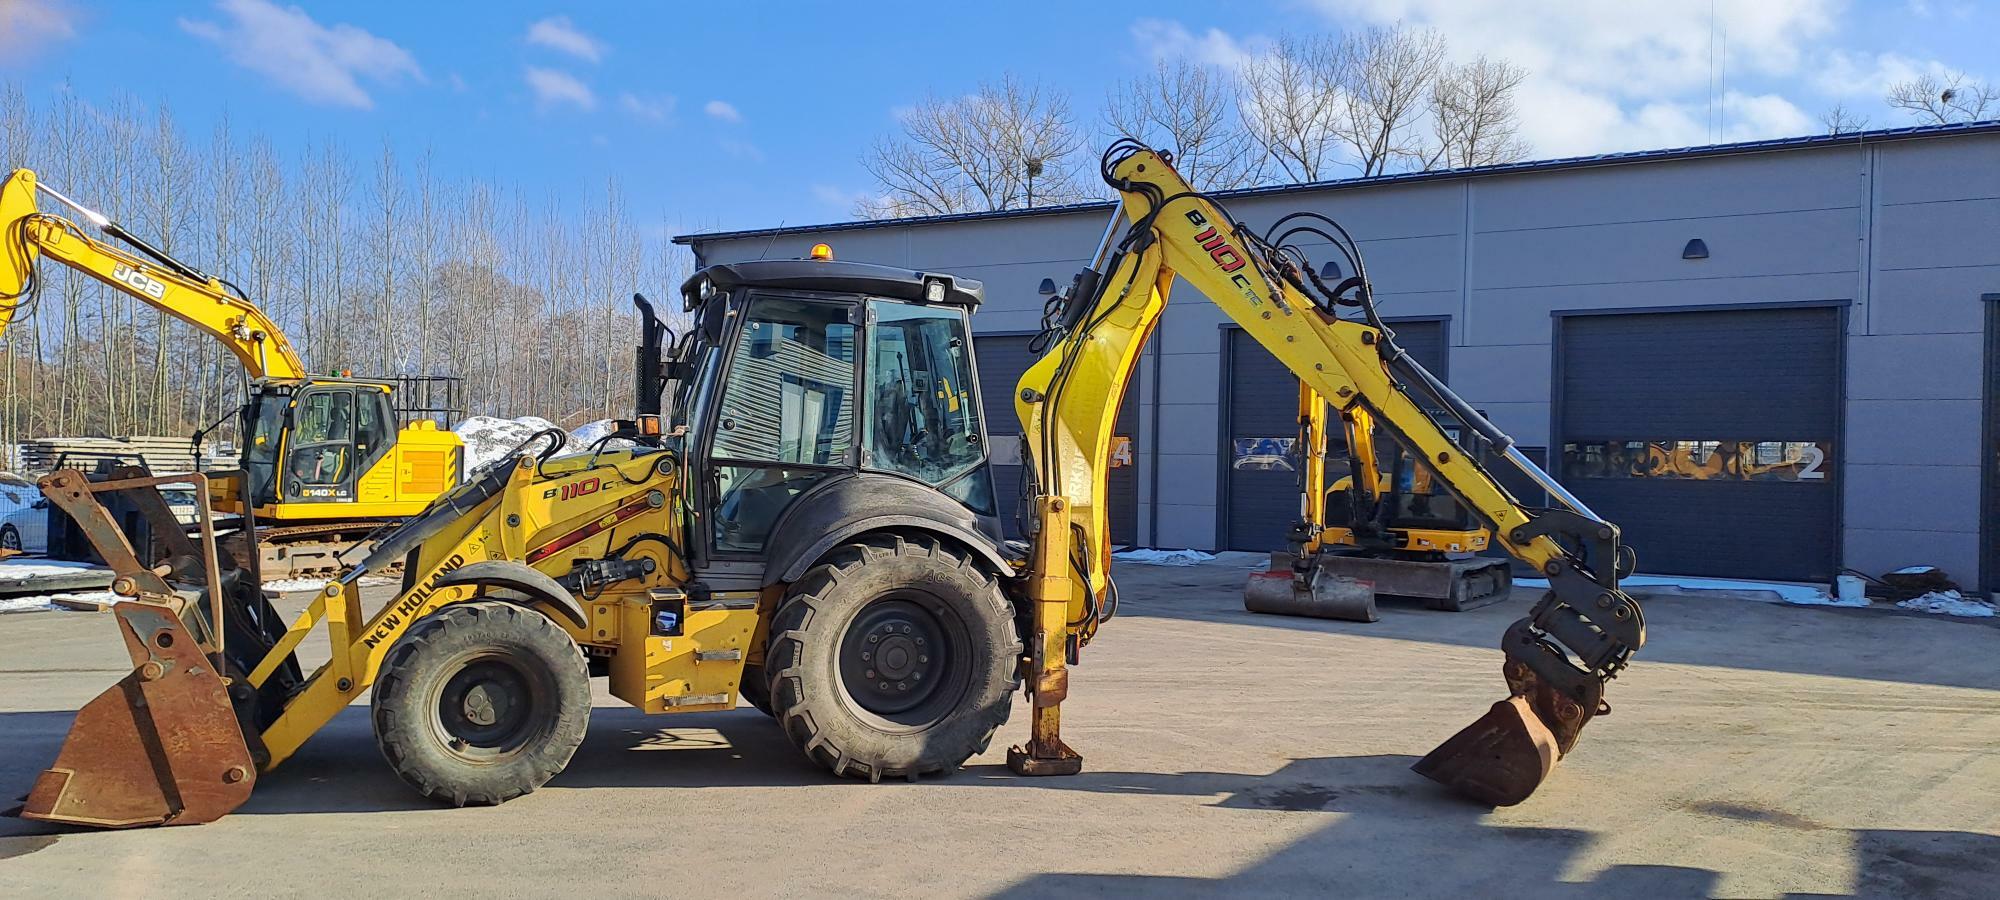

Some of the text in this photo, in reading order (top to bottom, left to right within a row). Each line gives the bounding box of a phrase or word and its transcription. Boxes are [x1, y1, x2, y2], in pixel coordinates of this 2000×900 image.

[112, 261, 166, 299] JCB
[1112, 440, 1130, 466] 4
[1798, 446, 1825, 479] 2
[561, 477, 601, 501] 110
[363, 553, 465, 649] NEW HOLLAND
